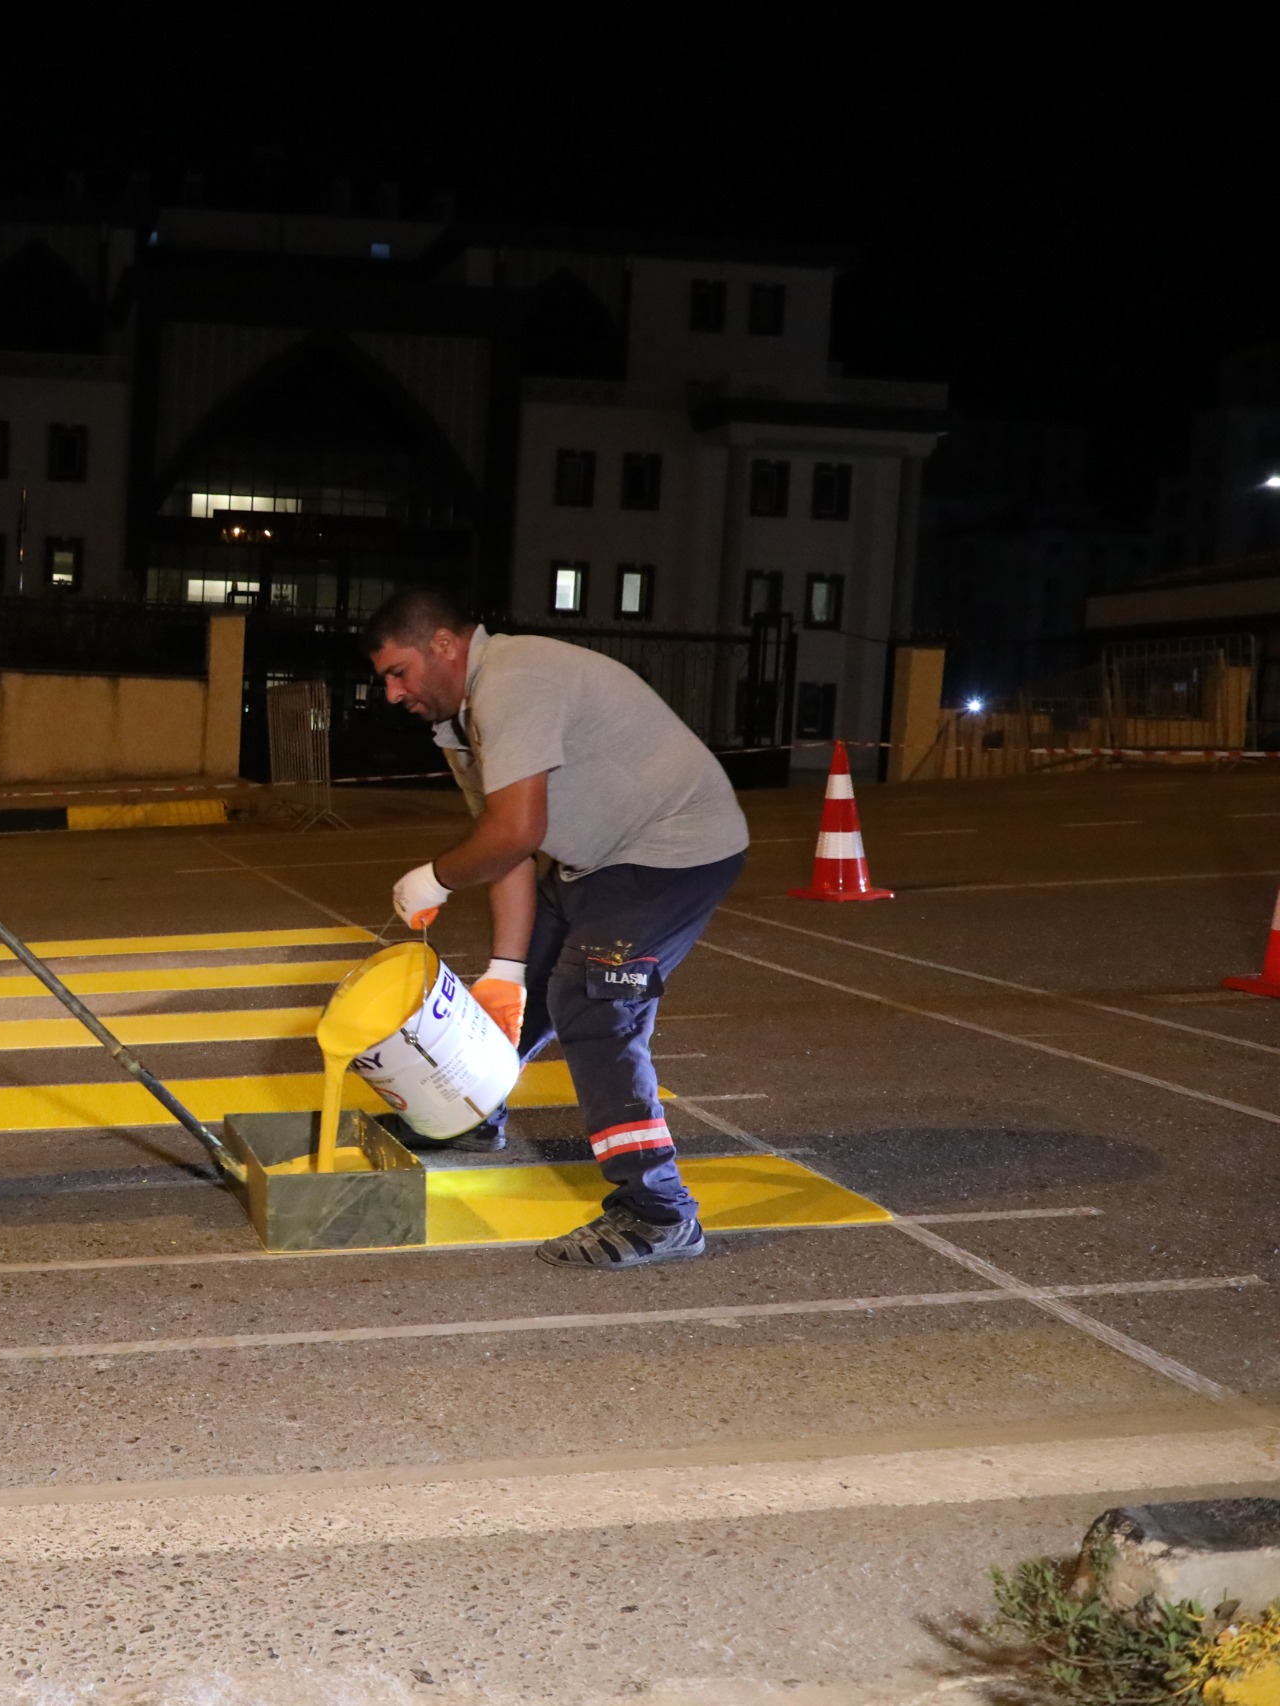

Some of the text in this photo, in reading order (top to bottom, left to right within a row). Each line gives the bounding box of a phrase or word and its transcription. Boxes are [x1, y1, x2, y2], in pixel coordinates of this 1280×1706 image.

[605, 971, 648, 987] ULAŞIM
[433, 970, 456, 1020] ÇEL
[349, 1052, 383, 1070] AY
